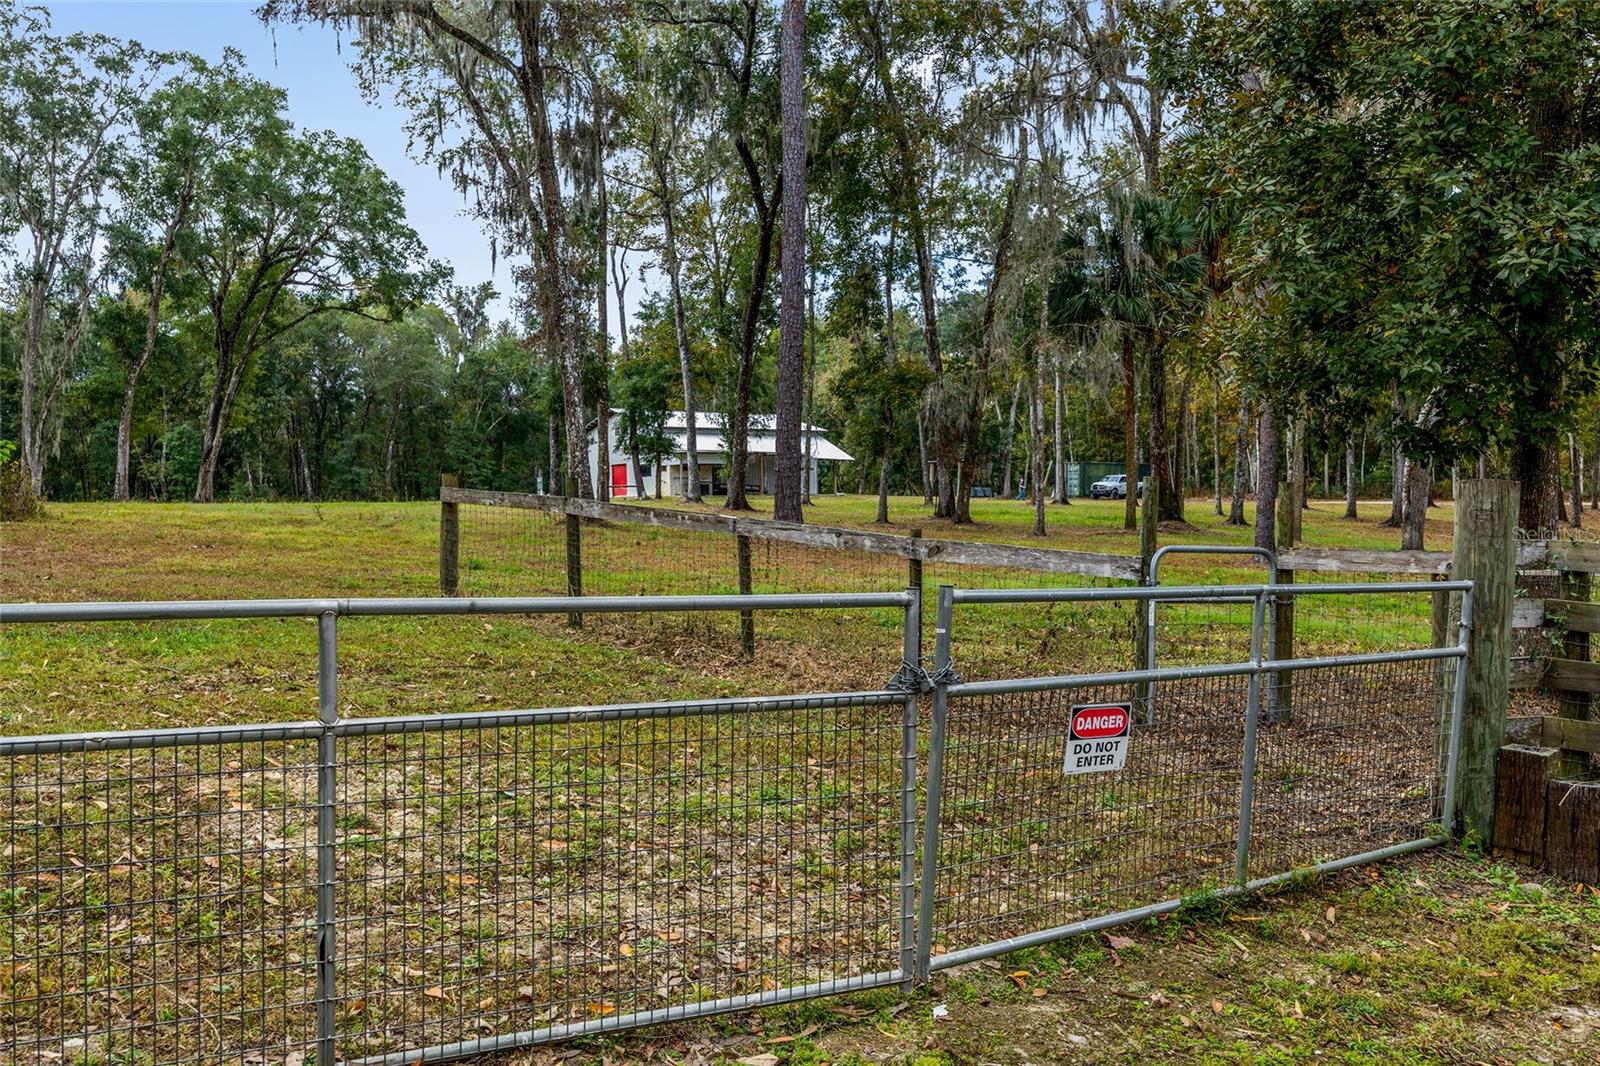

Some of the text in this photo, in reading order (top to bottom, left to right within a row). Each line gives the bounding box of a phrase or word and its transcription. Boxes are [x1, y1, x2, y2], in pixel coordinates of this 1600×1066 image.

[1076, 715, 1124, 730] DANGER
[1073, 741, 1121, 755] DO NOT
[1076, 754, 1115, 768] ENTER
